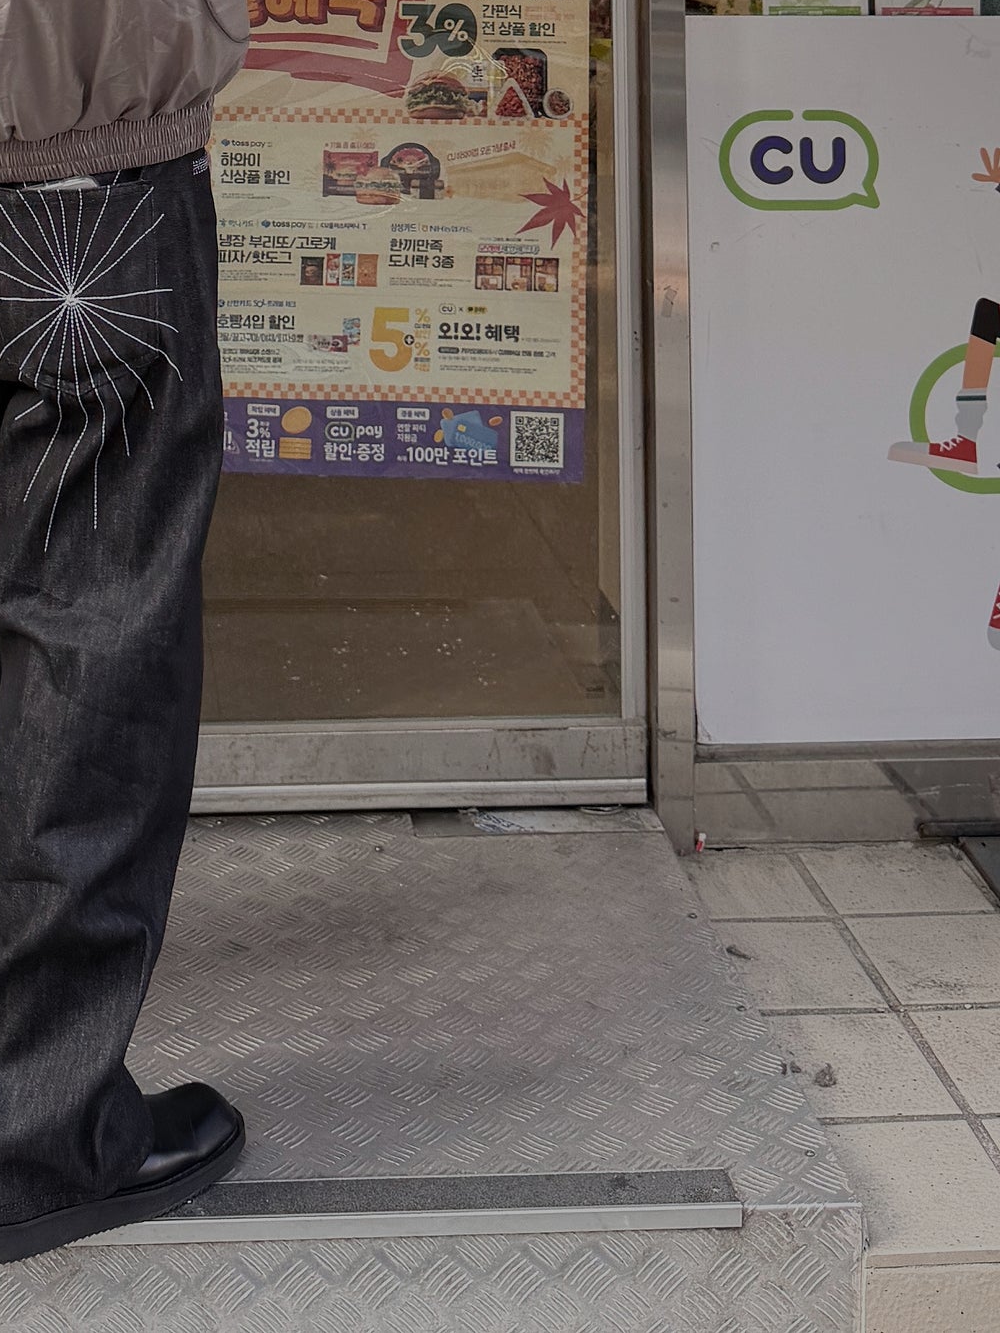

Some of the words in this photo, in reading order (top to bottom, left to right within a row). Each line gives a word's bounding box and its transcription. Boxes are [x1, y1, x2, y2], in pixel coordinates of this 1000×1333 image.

[482, 4, 521, 19] 간편식
[482, 21, 495, 36] 전
[498, 21, 526, 36] 상품
[528, 22, 555, 37] 할인
[221, 152, 260, 167] 하와이
[750, 135, 846, 184] CU
[220, 170, 260, 184] 신상품
[264, 170, 290, 185] 할인
[272, 220, 290, 228] toss
[291, 221, 306, 229] pay
[219, 234, 246, 247] 냉장
[249, 235, 336, 250] 부리또/고로케
[389, 238, 443, 252] 한끼만족
[218, 250, 292, 264] 피자/핫도그
[388, 254, 429, 268] 도시락
[432, 255, 454, 269] 3종
[268, 315, 295, 330] 할인
[415, 309, 431, 323] %
[369, 307, 414, 372] 5
[438, 322, 481, 341] 오!오!
[484, 324, 520, 342] 혜택
[414, 342, 430, 356] %
[246, 419, 271, 438] 3%
[330, 425, 349, 436] CU
[356, 425, 383, 439] pay
[245, 439, 275, 458] 적립
[406, 447, 448, 465] 100만
[452, 448, 498, 466] 포인트
